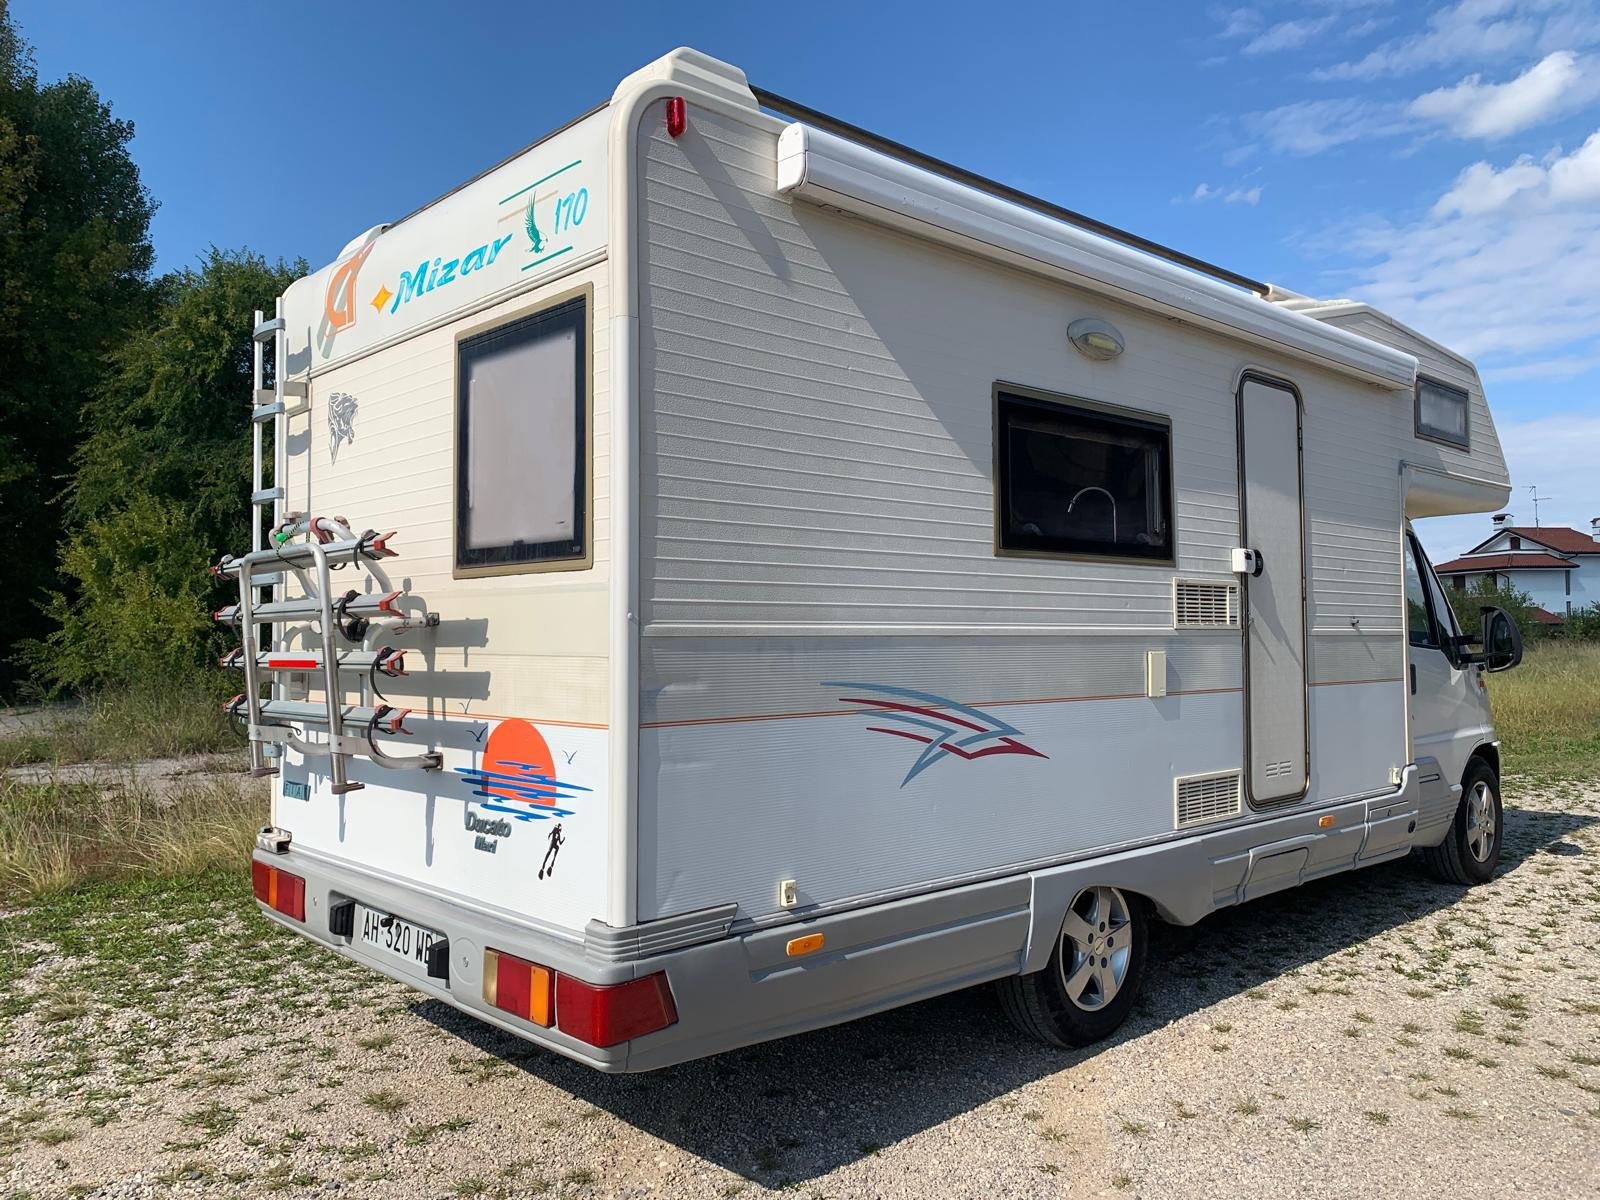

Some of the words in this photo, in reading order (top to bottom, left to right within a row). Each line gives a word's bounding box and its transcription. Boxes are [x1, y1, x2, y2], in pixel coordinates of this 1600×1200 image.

[554, 187, 588, 235] 170
[390, 233, 513, 315] Mizar
[465, 811, 512, 838] Ducato
[363, 911, 380, 944] AH
[385, 922, 411, 956] 320
